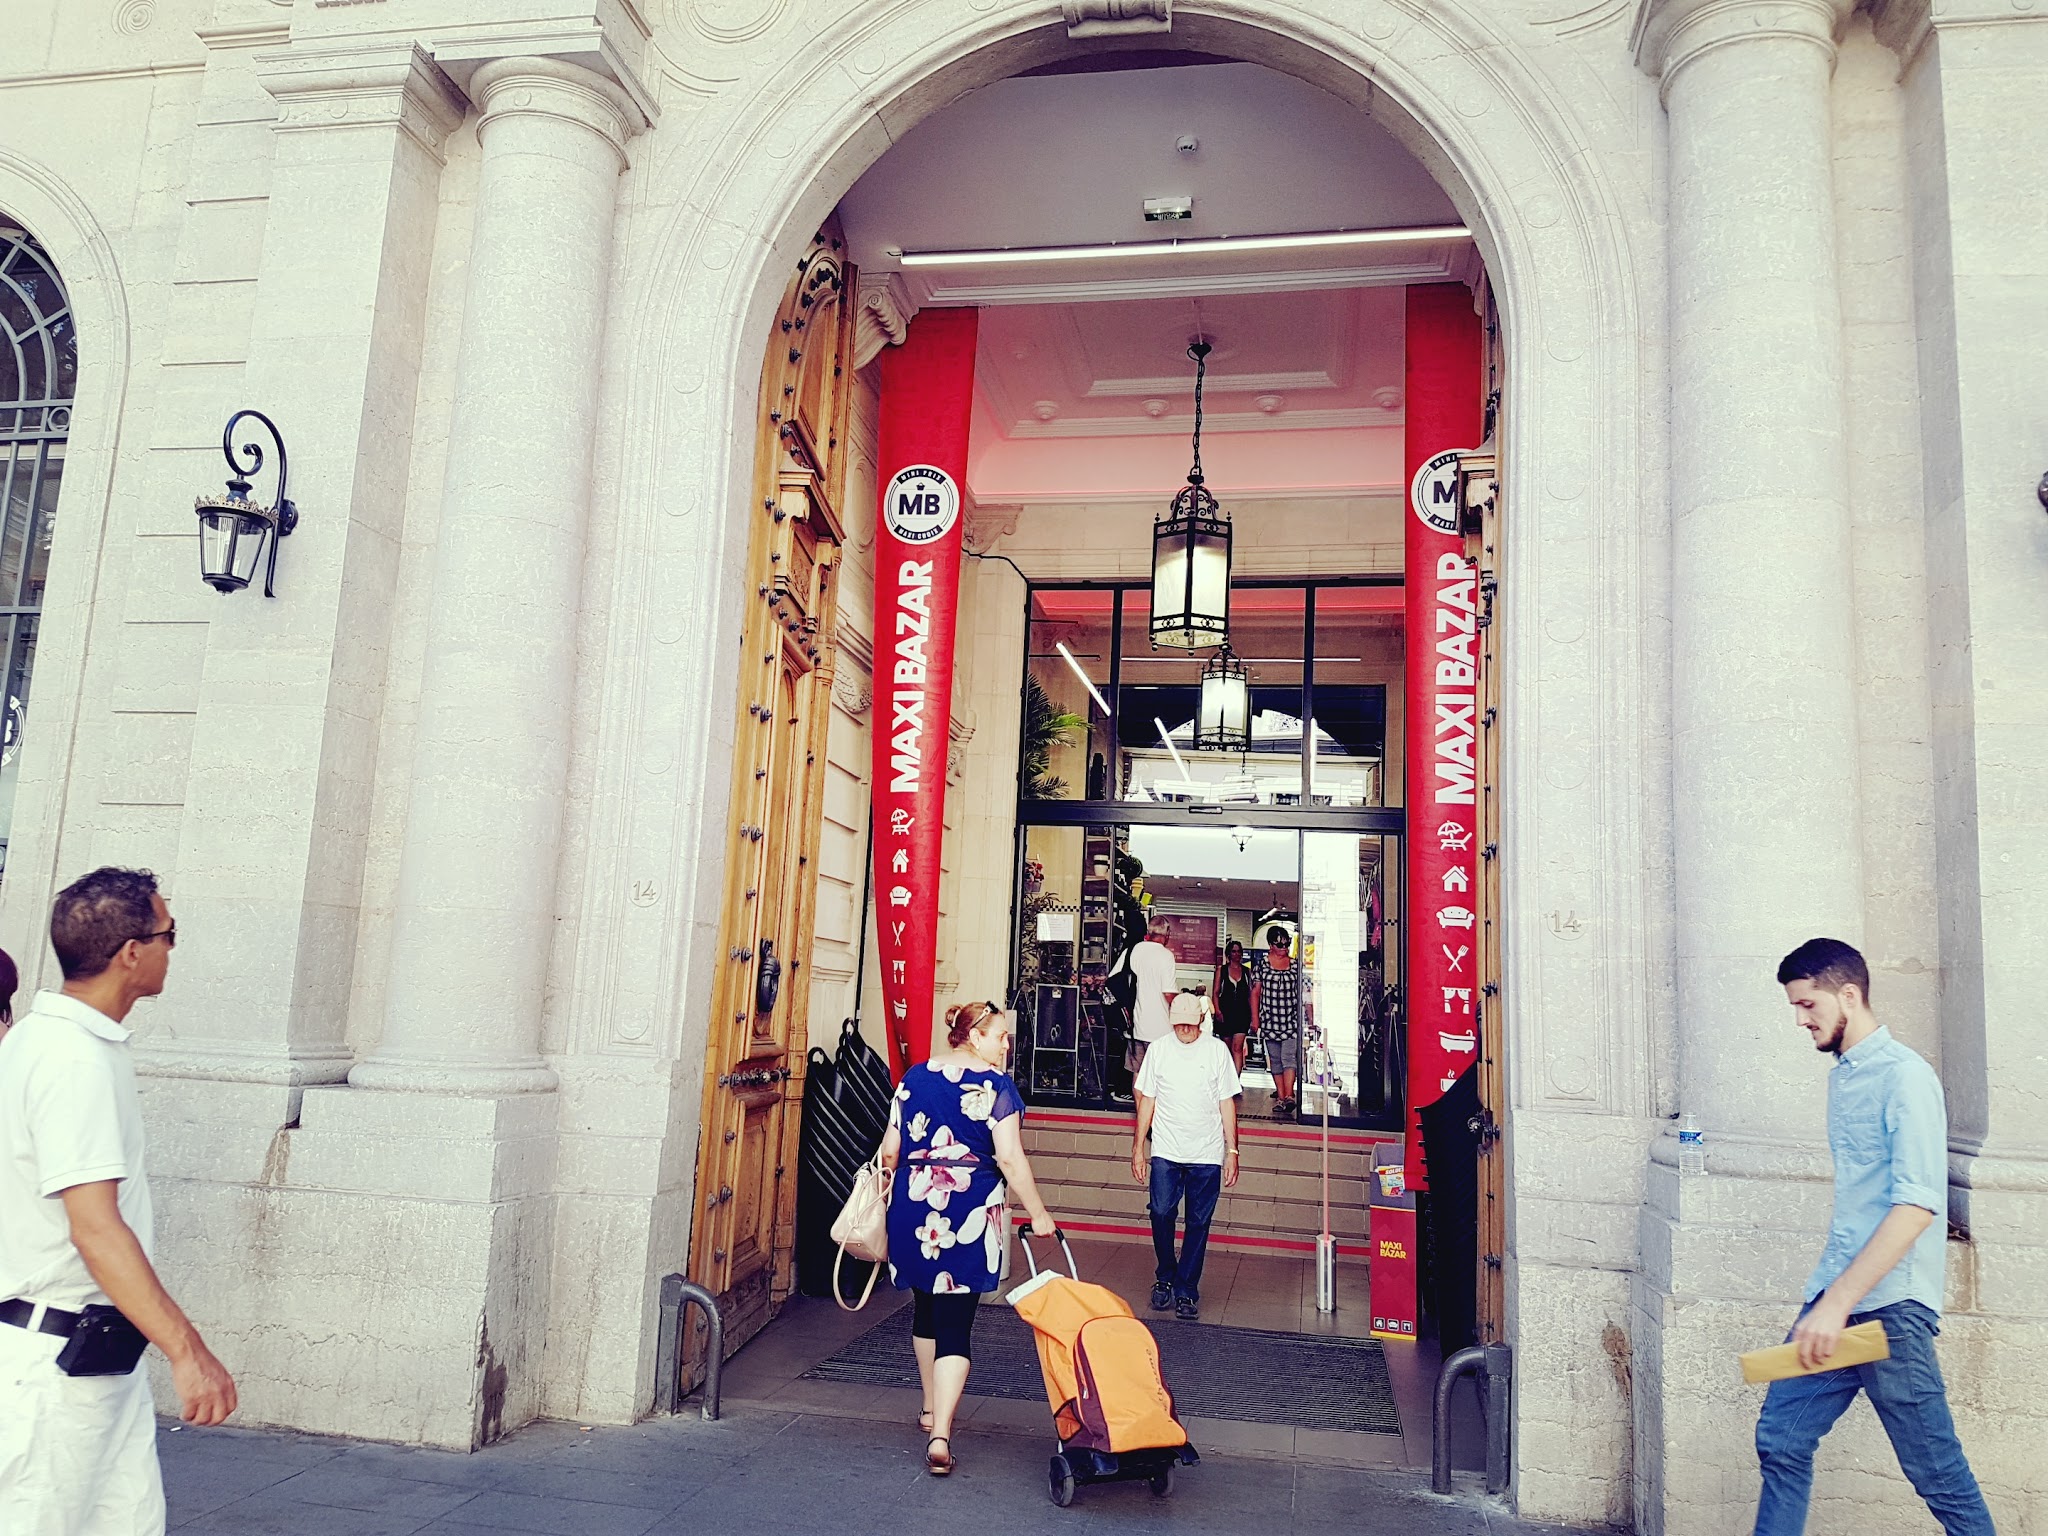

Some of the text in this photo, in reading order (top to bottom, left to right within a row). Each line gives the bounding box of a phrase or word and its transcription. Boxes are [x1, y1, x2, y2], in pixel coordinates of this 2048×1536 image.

[1434, 455, 1456, 468] MINI
[901, 470, 942, 481] MINI PRIX
[1433, 480, 1457, 504] M
[899, 493, 941, 516] MB
[1434, 517, 1454, 529] MAXI
[898, 528, 939, 540] MAXI CHOIX
[890, 560, 933, 793] MAXI BAZAR
[1435, 552, 1478, 805] MAXI BAZAR
[633, 880, 657, 901] 14
[1550, 909, 1582, 933] 14
[1380, 1240, 1402, 1251] MAXI
[1380, 1248, 1407, 1259] BAZAR
